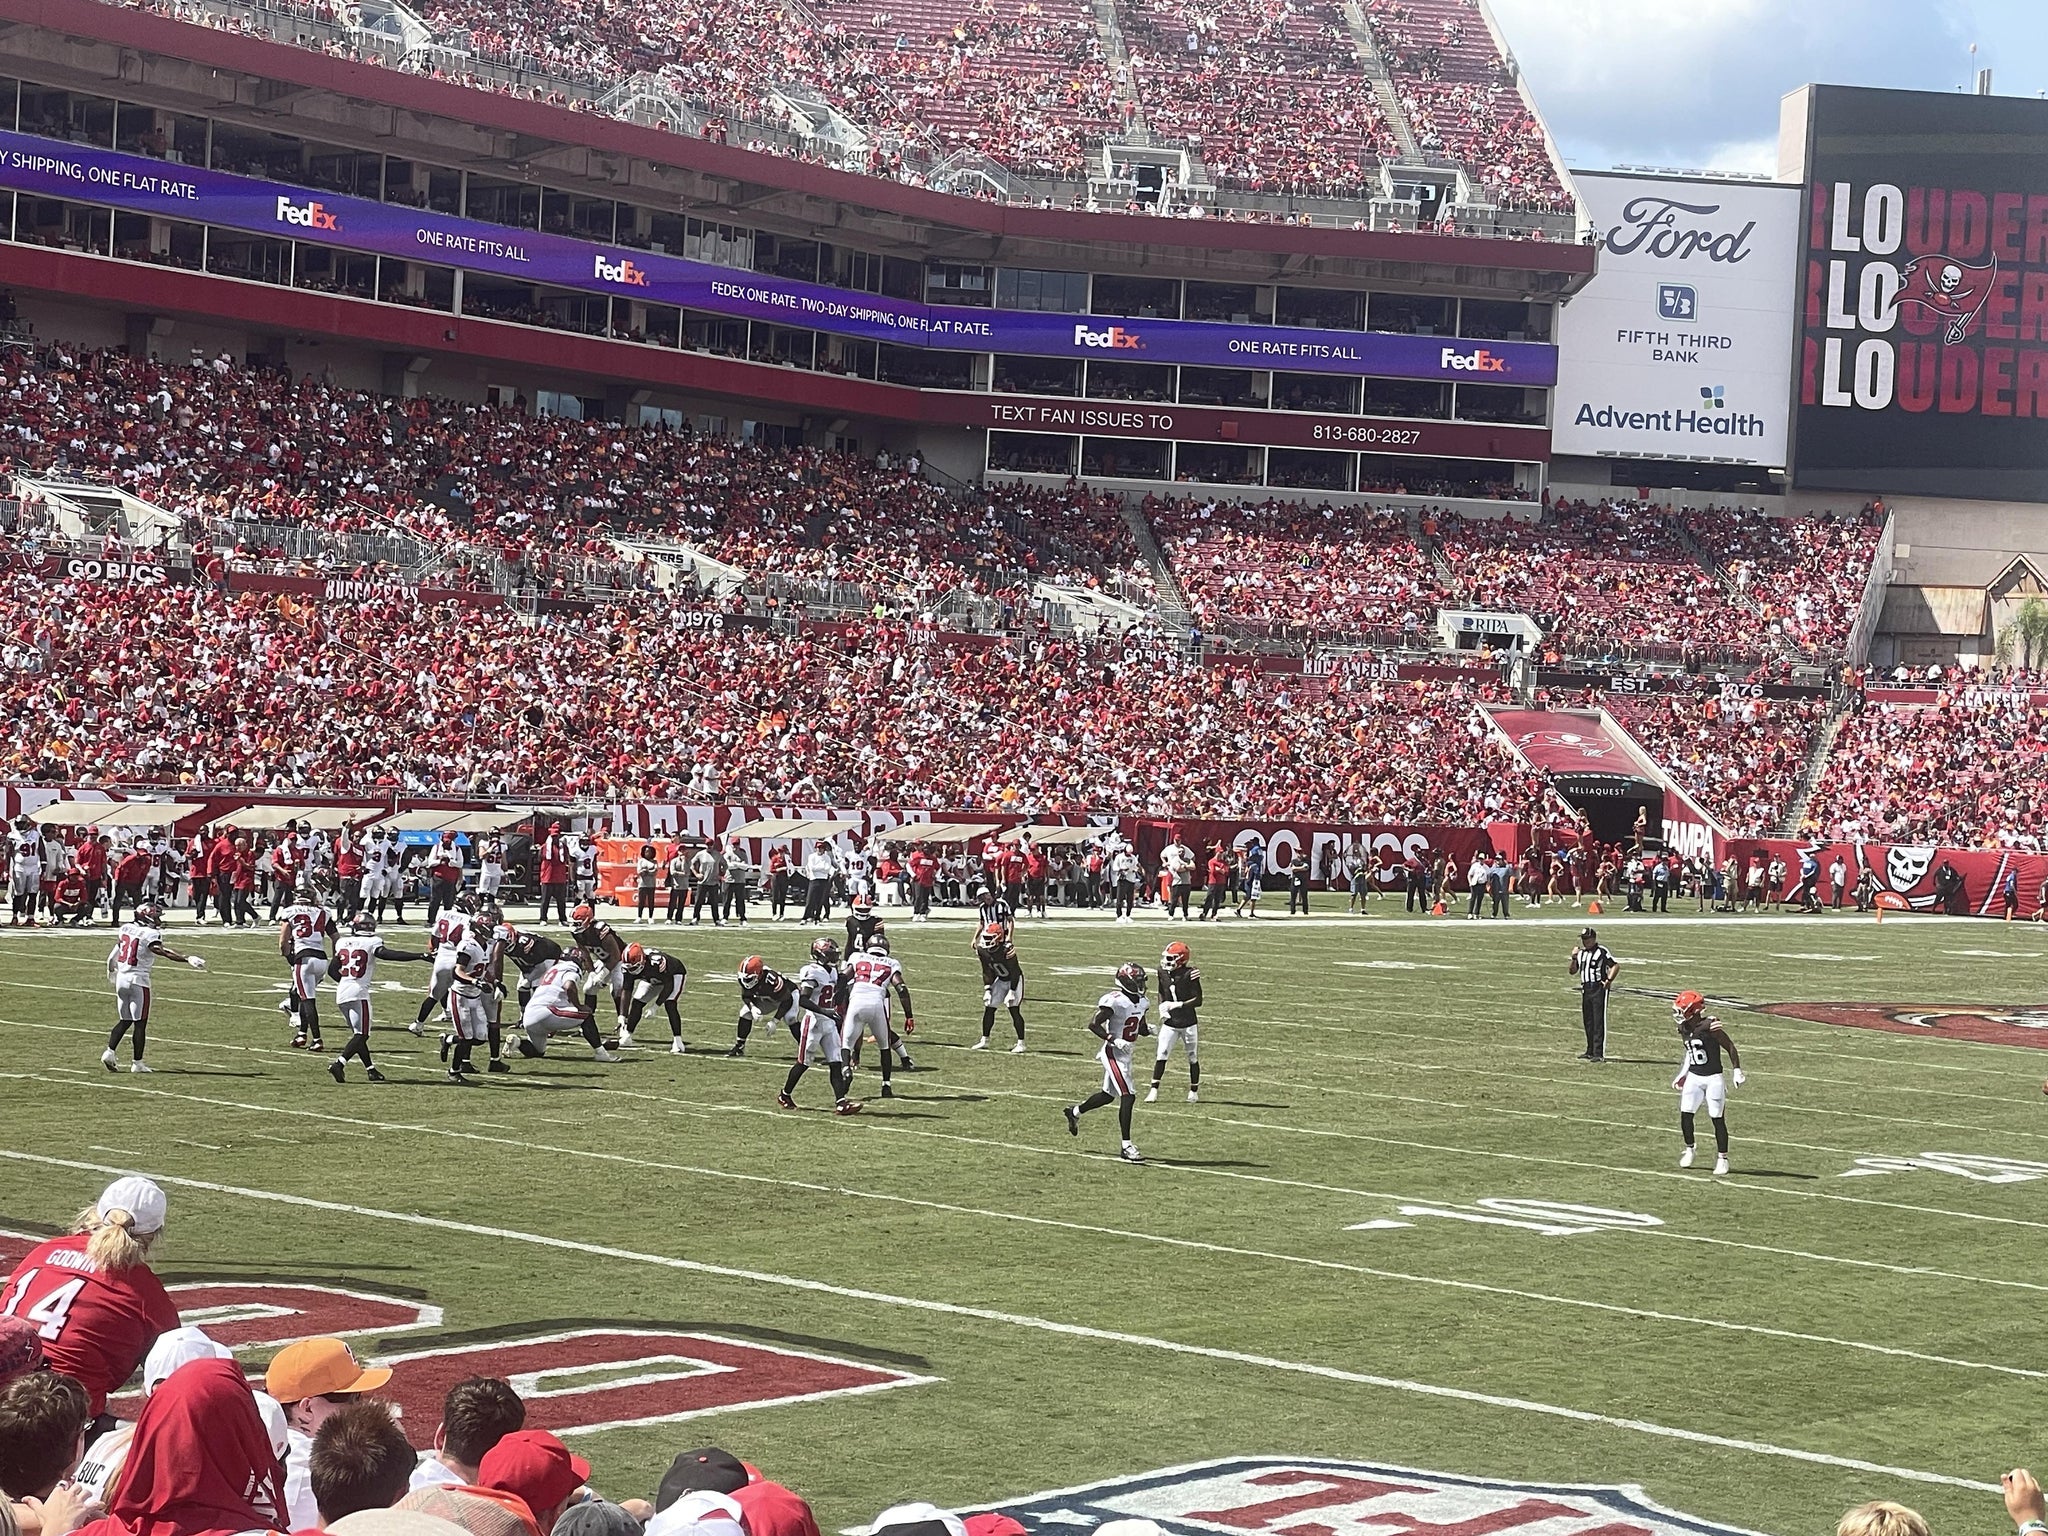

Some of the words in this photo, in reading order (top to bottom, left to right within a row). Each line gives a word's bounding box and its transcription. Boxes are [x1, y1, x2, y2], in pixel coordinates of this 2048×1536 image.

[12, 153, 85, 183] SHIPPING,
[88, 166, 120, 187] ONE
[124, 173, 157, 192] FLAT
[161, 180, 200, 200] RATE.
[277, 196, 338, 231] FedEx
[1606, 196, 1756, 263] Ford
[416, 229, 444, 246] ONE
[446, 234, 475, 252] RATE
[478, 240, 503, 257] FITS
[505, 245, 530, 262] ALL.
[594, 255, 645, 286] FedEx
[711, 281, 745, 300] FEDEX
[747, 288, 769, 304] ONE
[771, 291, 799, 309] RATE.
[801, 297, 848, 318] TWO-DAY
[850, 306, 897, 328] SHIPPING,
[898, 315, 918, 330] ONE
[954, 323, 993, 336] RATE.
[1827, 260, 2048, 341] LOER
[1074, 324, 1141, 349] FedEx
[1617, 329, 1669, 345] FIFTH
[1677, 333, 1732, 349] THIRD
[1228, 340, 1259, 353] ONE
[1262, 342, 1297, 356] RATE
[1301, 344, 1329, 358] FITS
[1332, 346, 1362, 360] ALL.
[1441, 348, 1504, 372] FedEx
[1653, 350, 1699, 364] BANK
[1822, 337, 2048, 417] LOUDER
[991, 405, 1036, 421] TEXT
[1041, 408, 1075, 424] FAN
[1080, 410, 1144, 428] ISSUES
[1148, 415, 1173, 430] TO
[1574, 403, 1764, 437] AdventHealth
[1313, 425, 1421, 445] 813-680-2827
[68, 559, 102, 579] GO
[106, 563, 166, 584] BUCS
[326, 579, 419, 602] BUCCAERS
[686, 612, 724, 628] 1976
[1475, 617, 1509, 632] RIPA
[1303, 659, 1398, 679] BUCANEERS
[1611, 677, 1651, 692] EST.
[1569, 786, 1625, 796] RELIAQUEST
[19, 842, 36, 858] 91
[1661, 818, 1715, 864] TAMPA
[295, 910, 325, 938] 34
[439, 918, 464, 944] 94
[118, 933, 140, 967] 31
[854, 933, 864, 951] 4
[338, 948, 369, 979] 23
[1122, 1016, 1139, 1042] 2
[1684, 1038, 1707, 1066] 16
[45, 1249, 97, 1274] GODWIN
[2, 1266, 88, 1342] 14
[77, 1461, 106, 1485] BUC
